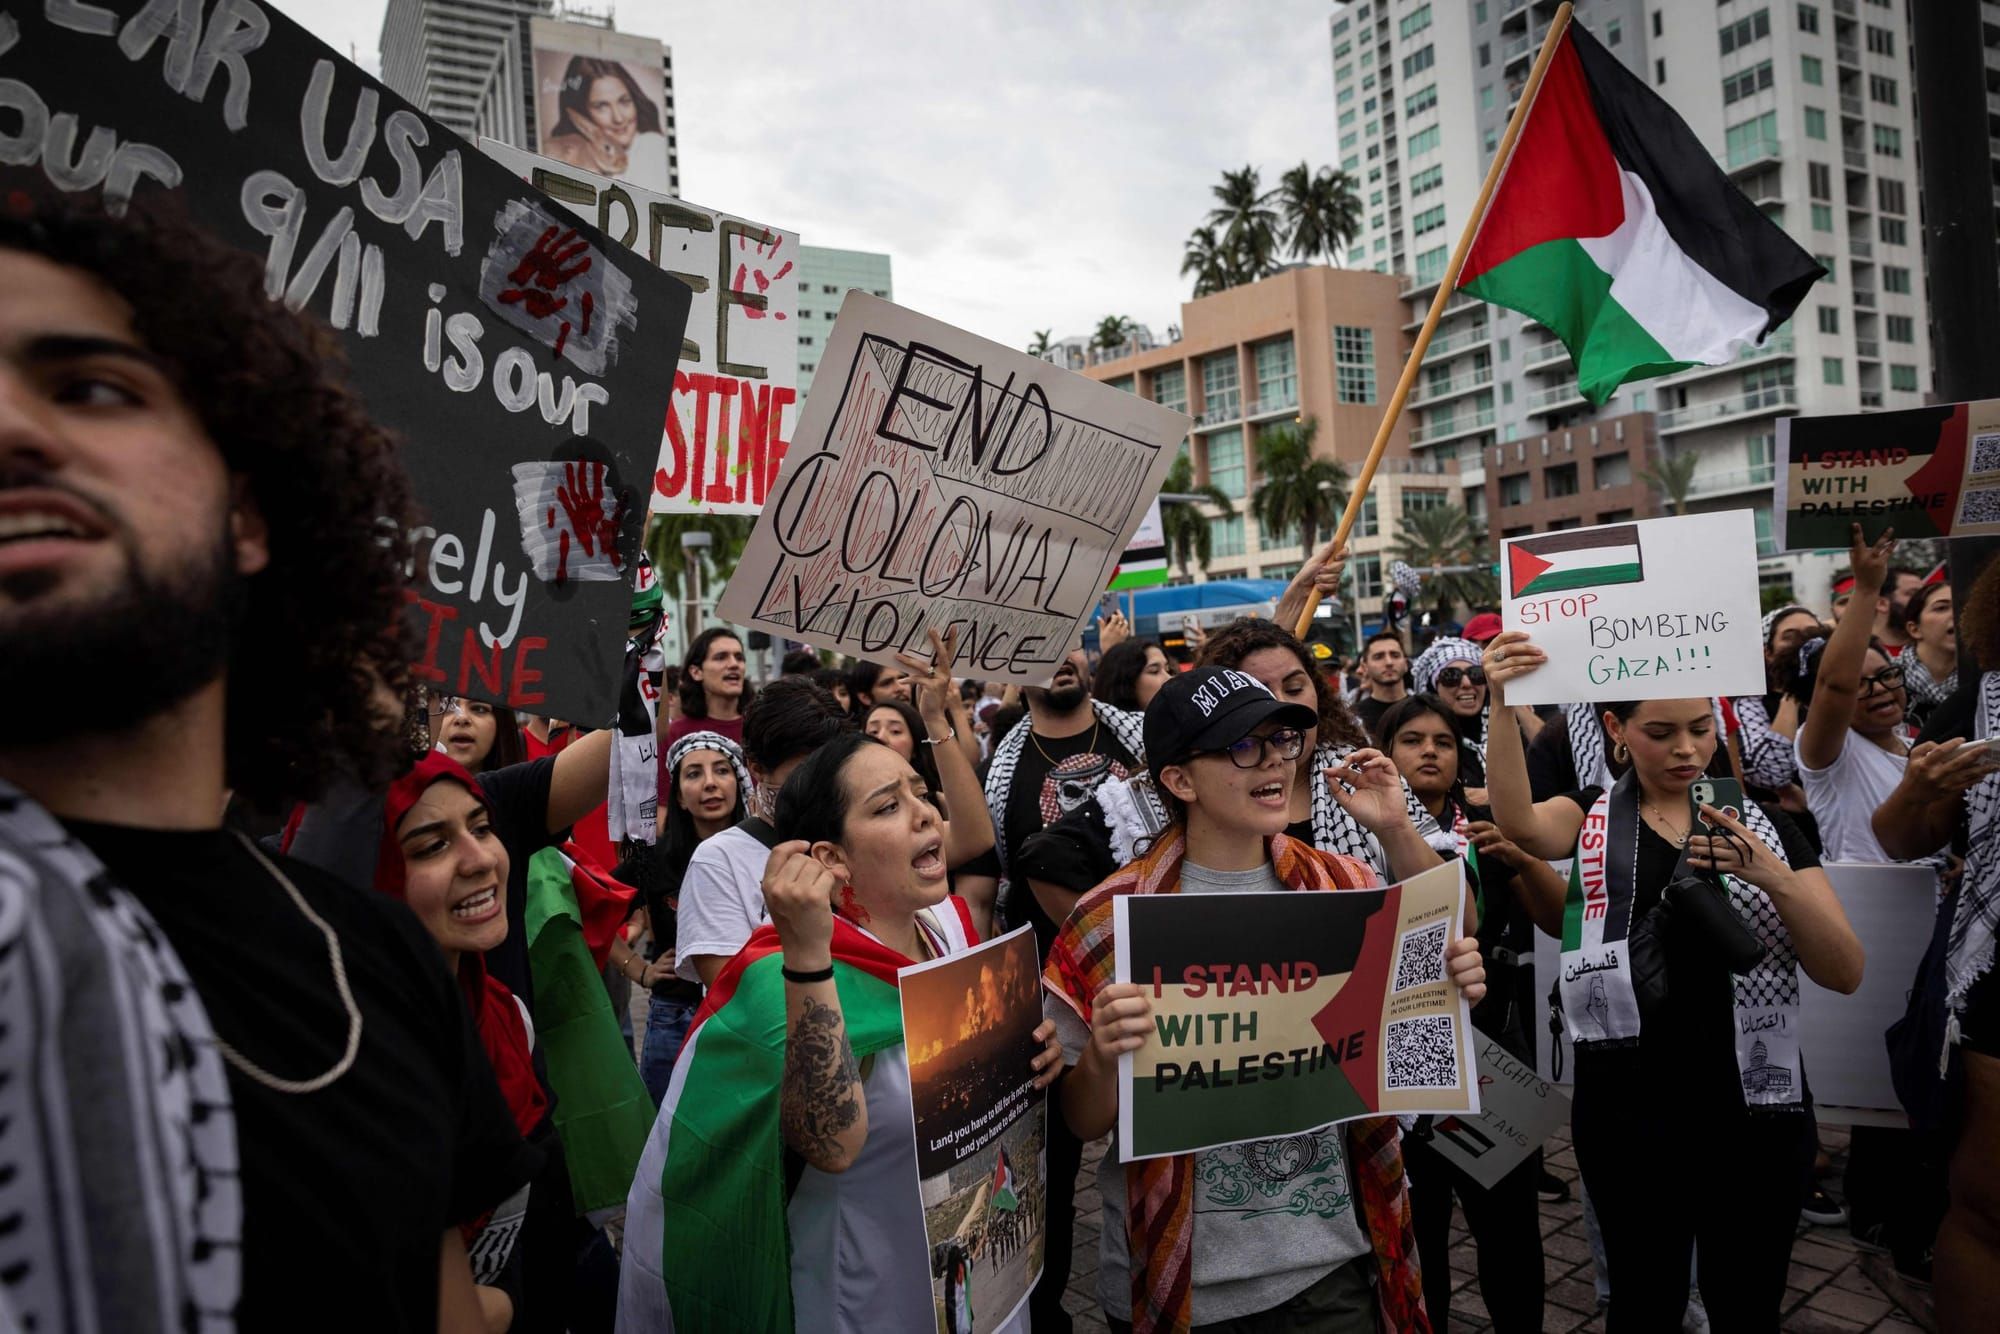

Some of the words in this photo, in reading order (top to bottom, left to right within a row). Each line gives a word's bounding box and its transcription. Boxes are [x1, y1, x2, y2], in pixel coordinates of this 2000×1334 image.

[301, 58, 464, 256] USA
[241, 170, 385, 337] 9/11
[424, 281, 485, 393] is
[493, 345, 608, 436] our
[877, 340, 1052, 475] END
[1802, 452, 1809, 471] I
[1820, 447, 1909, 470] STAND
[1802, 475, 1868, 496] WITH
[1800, 493, 1948, 518] PALESTINE
[773, 451, 1078, 619] COLONIAL
[1520, 593, 1598, 625] STOP
[1590, 611, 1729, 649] BOMBING
[1588, 645, 1712, 685] GAZA!!!
[1407, 914, 1423, 924] SCAN
[1423, 911, 1432, 919] TO
[1432, 905, 1449, 916] LEARN
[1153, 966, 1162, 999] I
[1183, 961, 1319, 998] STAND
[1565, 949, 1619, 981] فلسطين
[1391, 1007, 1398, 1015] IN
[1398, 1004, 1412, 1013] OUR
[1412, 999, 1446, 1010] LIFETIME!
[1396, 996, 1411, 1006] FREE
[1411, 989, 1448, 1001] PALESTINE
[1155, 1010, 1258, 1048] WITH
[1154, 1030, 1366, 1093] PALESTINE
[1481, 1043, 1550, 1098] RIGHTS
[930, 1131, 954, 1151] Land
[954, 1126, 970, 1143] you
[971, 1114, 988, 1131] have
[988, 1109, 995, 1120] to
[995, 1099, 1003, 1115] kill
[1003, 1095, 1011, 1109] for
[1011, 1090, 1016, 1101] is
[1016, 1084, 1025, 1099] not
[956, 1139, 975, 1160] Land
[975, 1133, 989, 1151] you
[989, 1120, 1002, 1138] have
[1002, 1116, 1008, 1128] to
[1008, 1108, 1017, 1123] die
